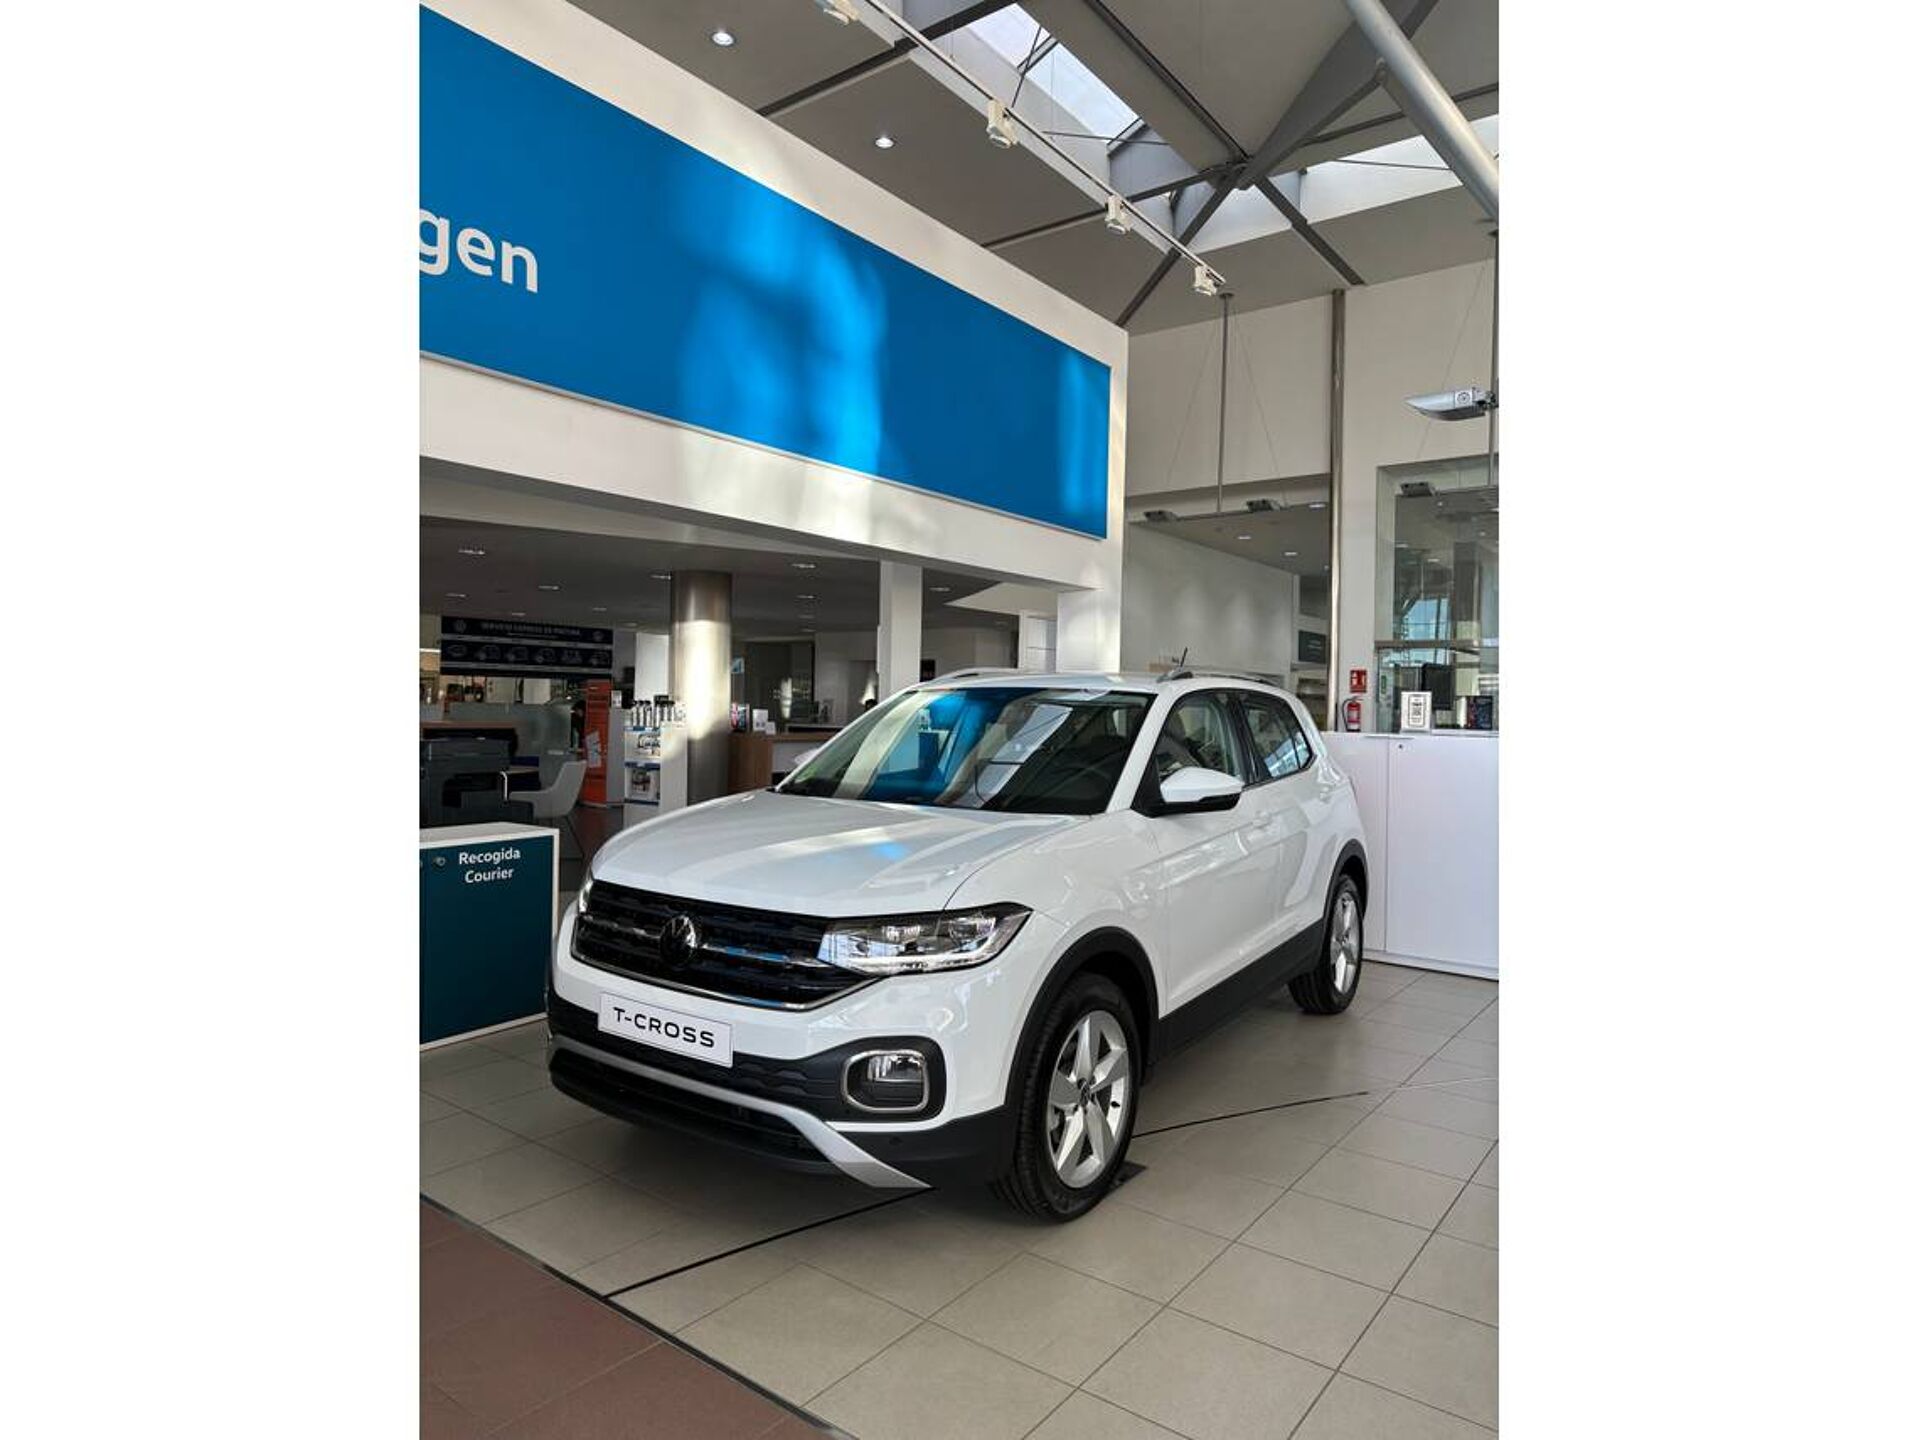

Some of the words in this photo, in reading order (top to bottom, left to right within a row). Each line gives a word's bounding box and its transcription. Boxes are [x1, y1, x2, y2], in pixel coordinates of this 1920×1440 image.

[420, 208, 538, 293] gen
[459, 847, 521, 865] Recogida
[465, 867, 514, 883] Courier
[613, 1007, 714, 1048] T-CROSS
